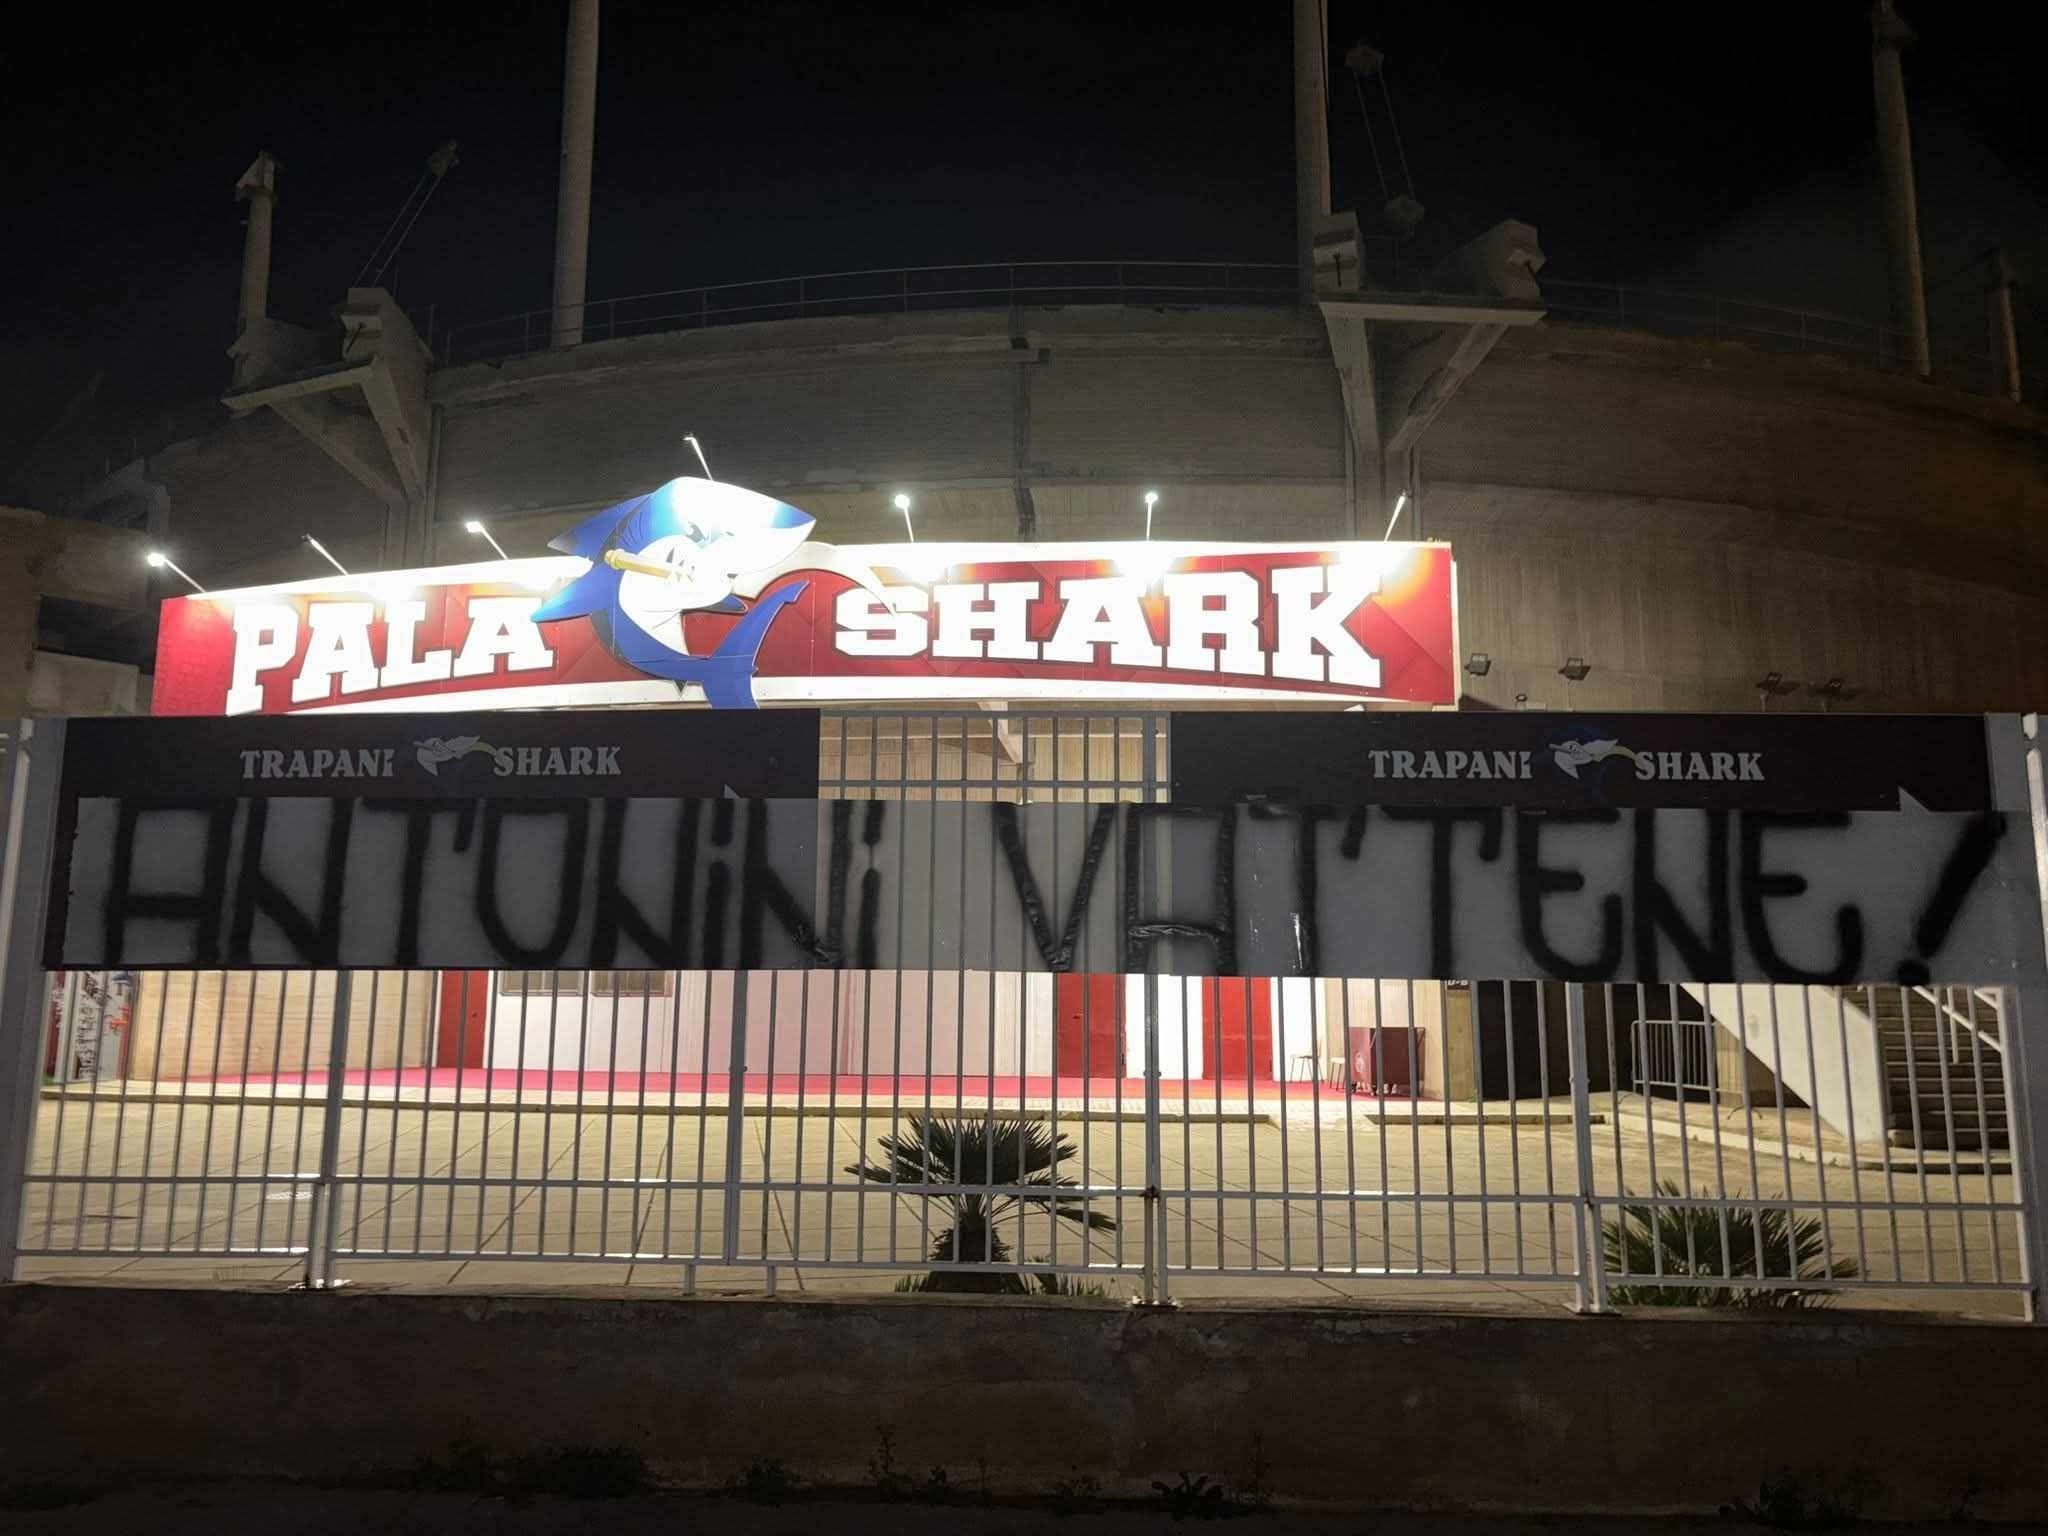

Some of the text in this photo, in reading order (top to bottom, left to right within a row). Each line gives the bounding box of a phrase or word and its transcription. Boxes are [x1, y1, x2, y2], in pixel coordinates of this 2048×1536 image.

[226, 563, 1382, 716] PALA SHARK
[239, 746, 622, 779] TRAPANI SHARK
[1367, 749, 1766, 781] TRAPANI SHARK
